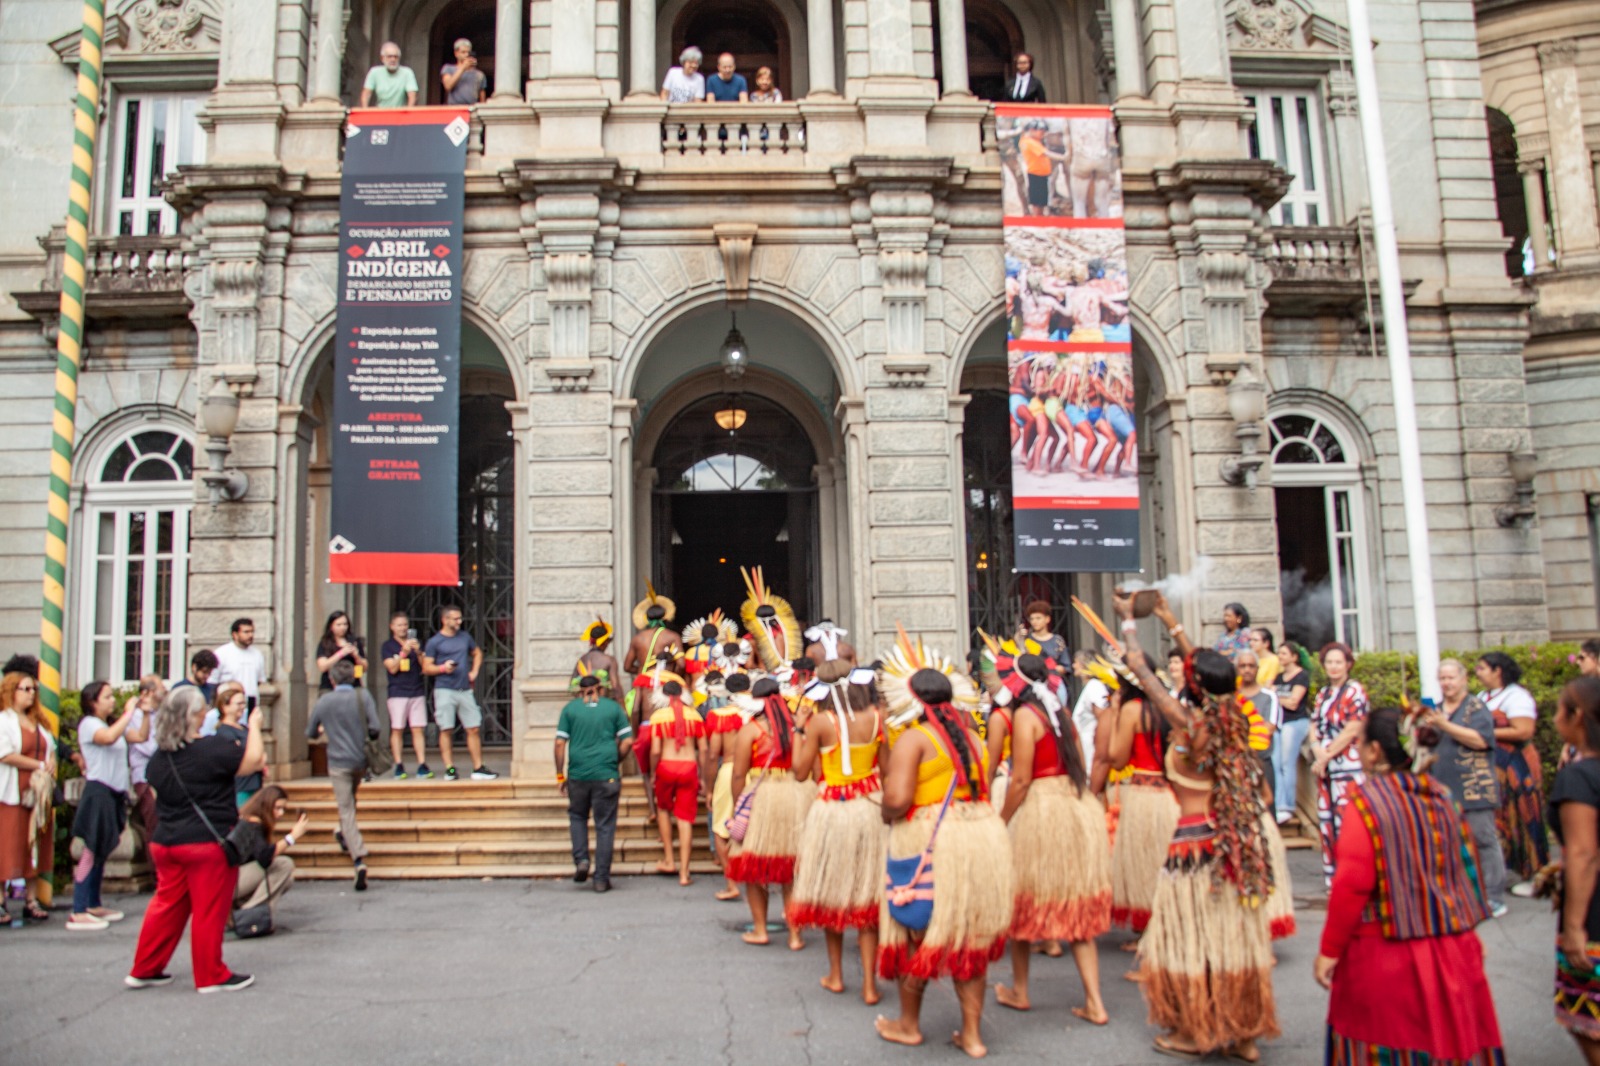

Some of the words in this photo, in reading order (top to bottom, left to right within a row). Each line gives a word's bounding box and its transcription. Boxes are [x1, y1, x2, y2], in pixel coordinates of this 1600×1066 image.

[349, 227, 400, 239] OCUPAÇÃO
[400, 227, 451, 238] ARTÍSTICA
[365, 241, 430, 258] ABRIL
[347, 258, 452, 278] INDÍGENA
[347, 280, 412, 289] DEMARCANDO
[413, 280, 452, 288] MENTES
[346, 289, 356, 300] E
[358, 289, 452, 302] PENSAMENTO
[368, 412, 423, 422] ABERTURA
[370, 460, 420, 469] ENTRADA
[368, 471, 421, 481] GRATUITA
